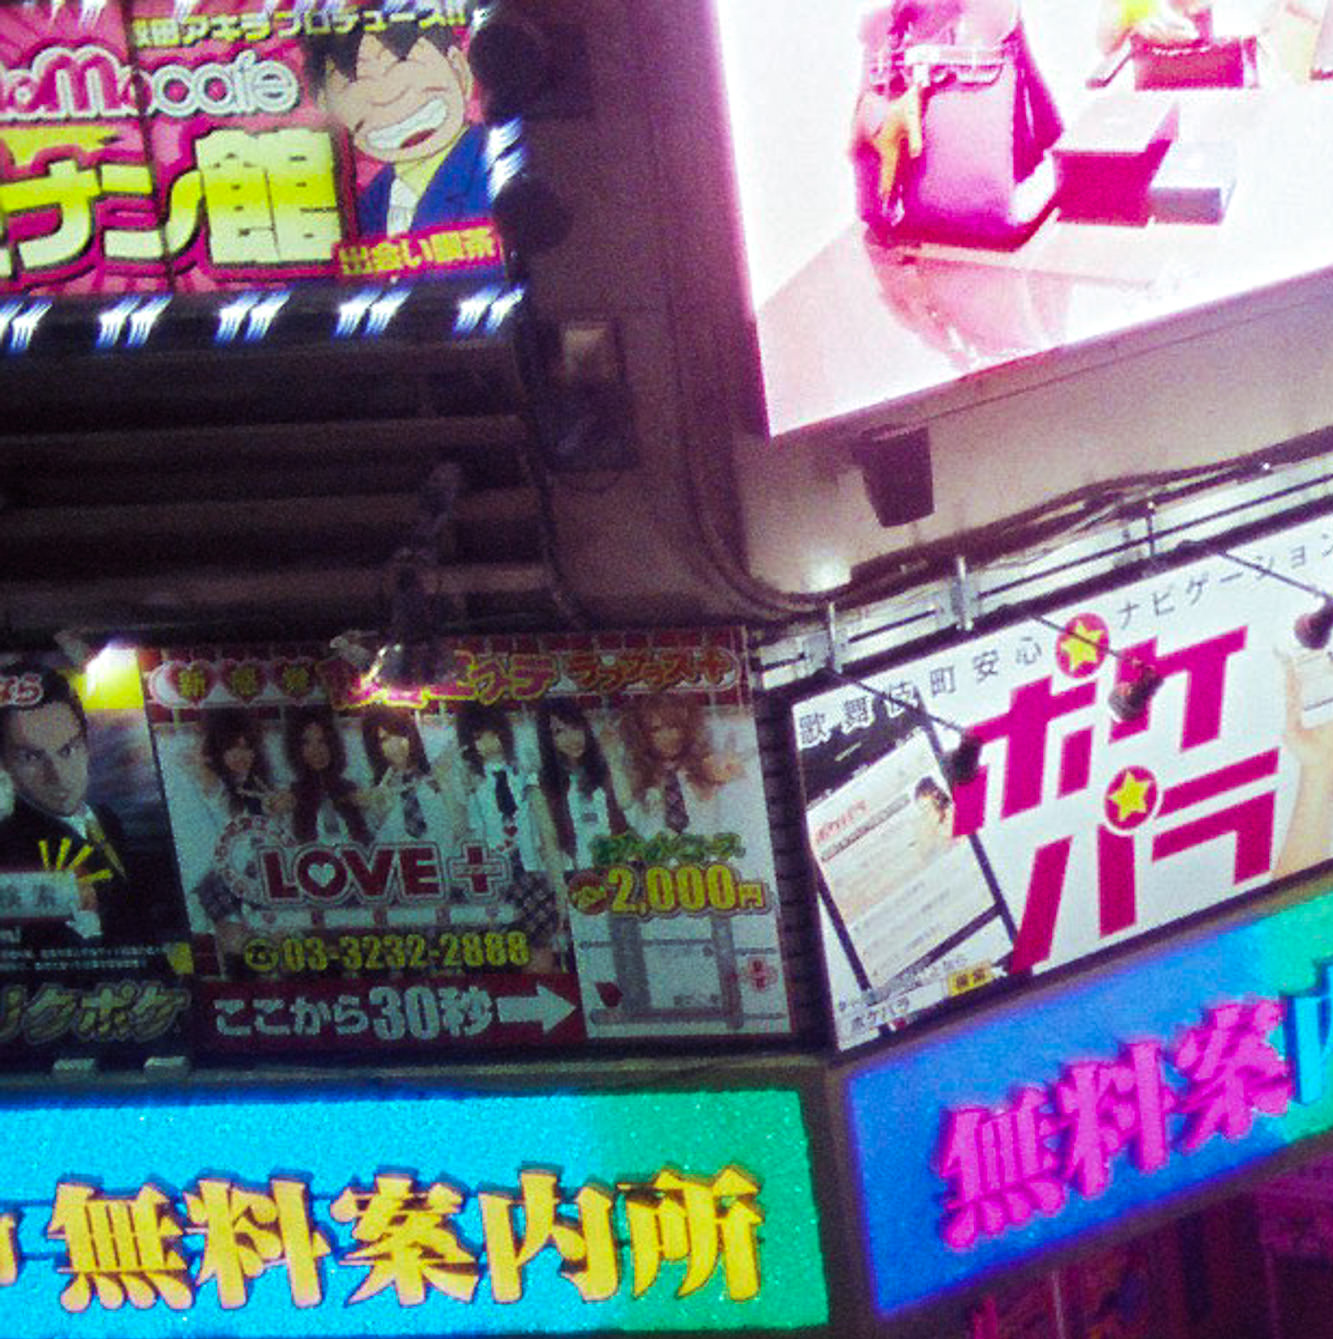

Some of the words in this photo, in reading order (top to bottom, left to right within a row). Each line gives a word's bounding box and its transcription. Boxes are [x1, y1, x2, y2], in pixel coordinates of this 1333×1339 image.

[607, 863, 766, 914] 2,000円
[214, 985, 494, 1041] ここから30秒
[48, 1168, 767, 1313] 無料案内所
